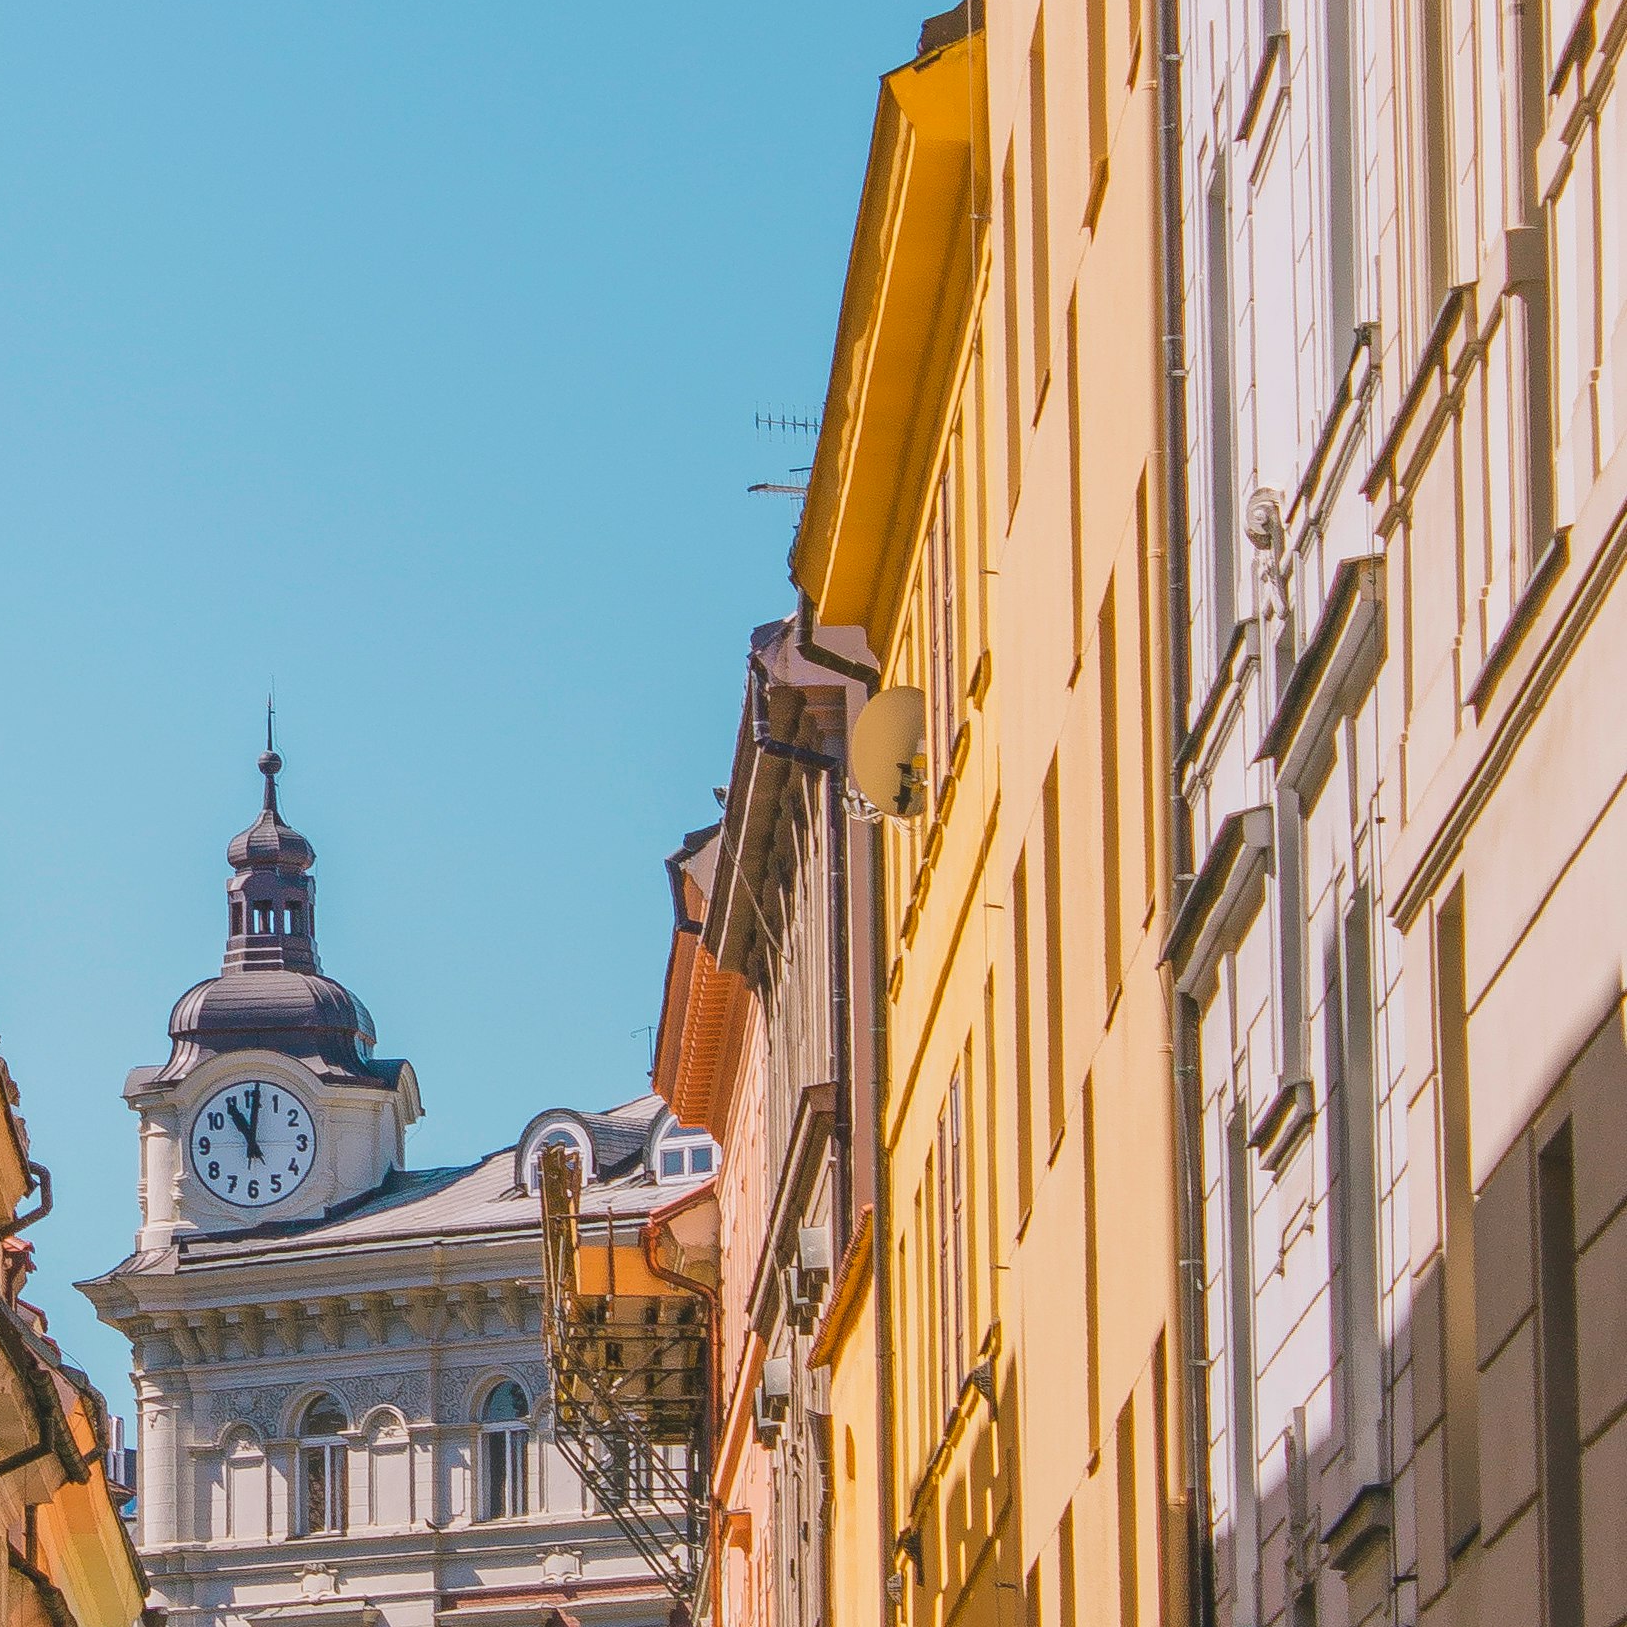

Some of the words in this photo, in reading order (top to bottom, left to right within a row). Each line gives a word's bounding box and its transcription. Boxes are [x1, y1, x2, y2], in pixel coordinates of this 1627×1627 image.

[272, 1094, 279, 1114] 1
[207, 1112, 224, 1131] 10
[288, 1109, 299, 1127] 2
[199, 1136, 210, 1155] 9
[296, 1134, 308, 1152] 3
[208, 1161, 220, 1180] 8
[288, 1158, 299, 1176] 4
[227, 1175, 238, 1194] 7
[248, 1179, 259, 1199] 6
[270, 1174, 282, 1193] 5
